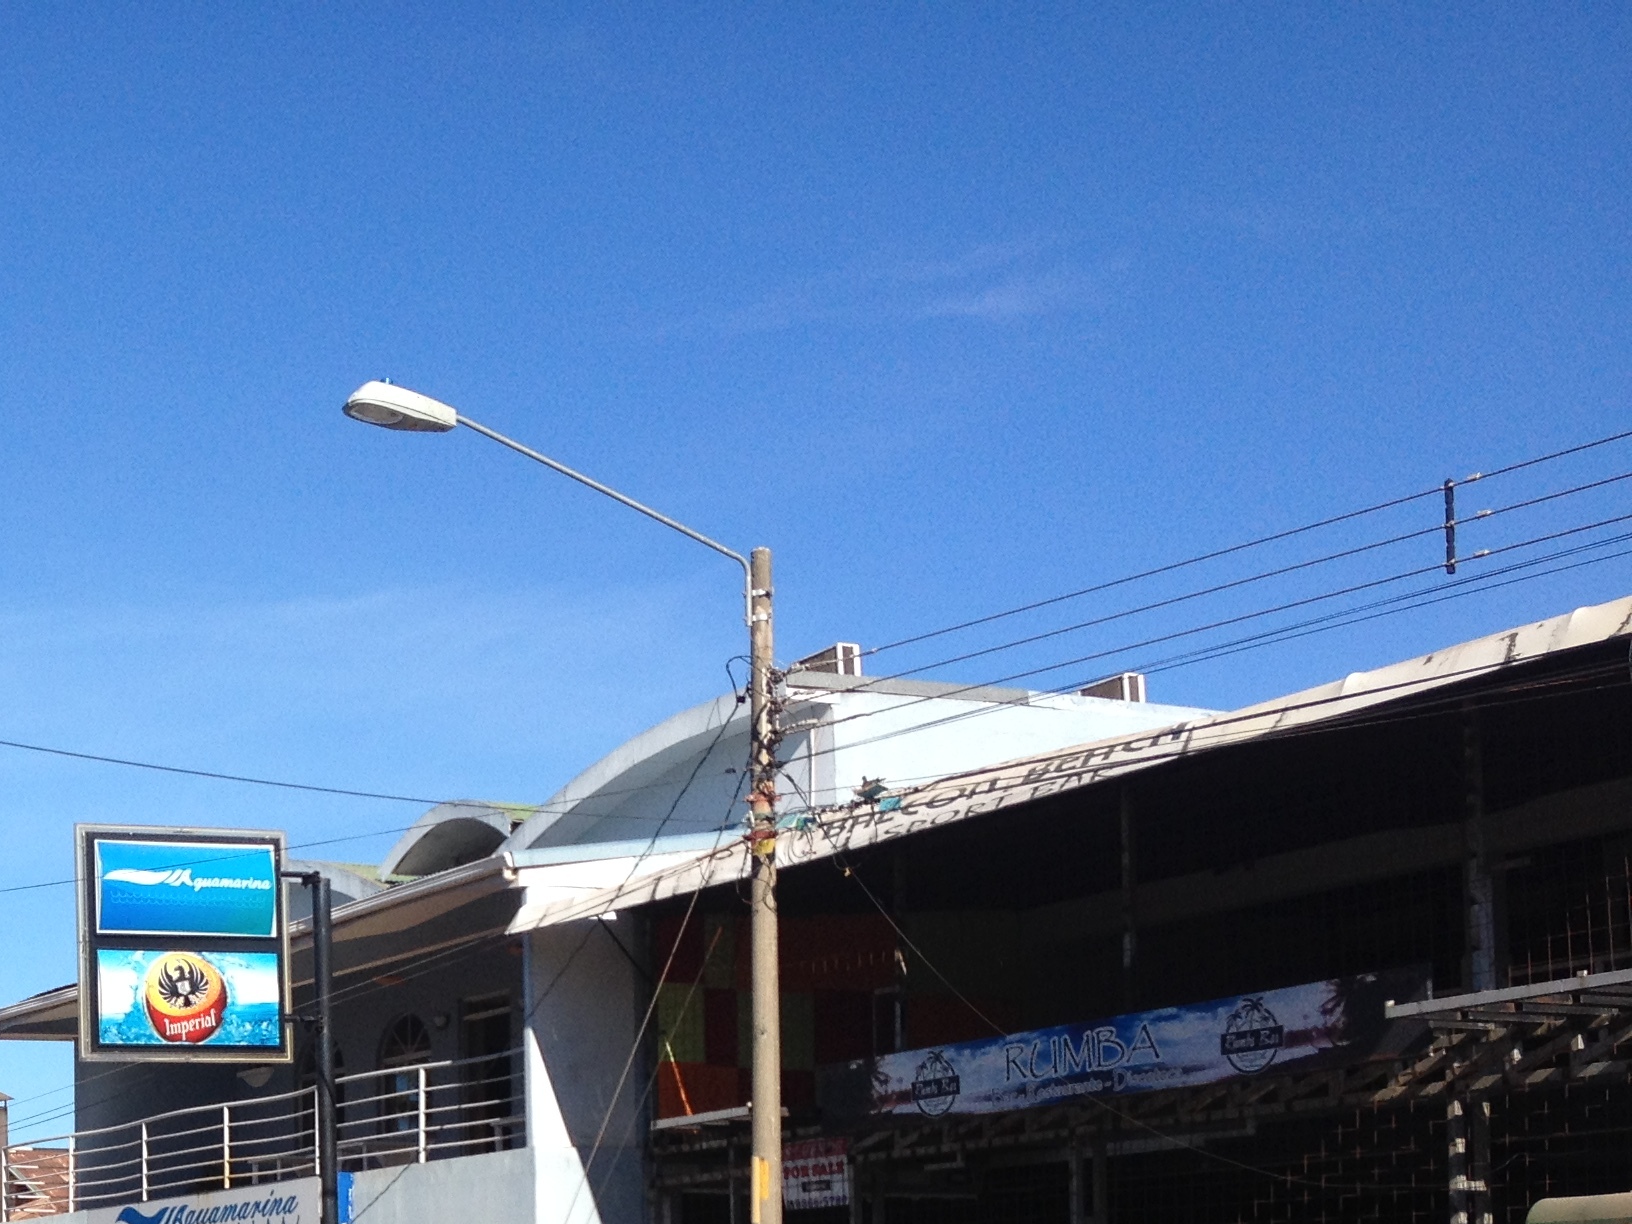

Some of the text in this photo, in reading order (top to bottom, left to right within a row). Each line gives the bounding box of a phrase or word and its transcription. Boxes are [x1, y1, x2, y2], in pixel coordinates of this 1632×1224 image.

[175, 868, 272, 893] Aguamarina
[164, 1008, 217, 1041] Imperial
[1004, 1022, 1160, 1083] RUMBA
